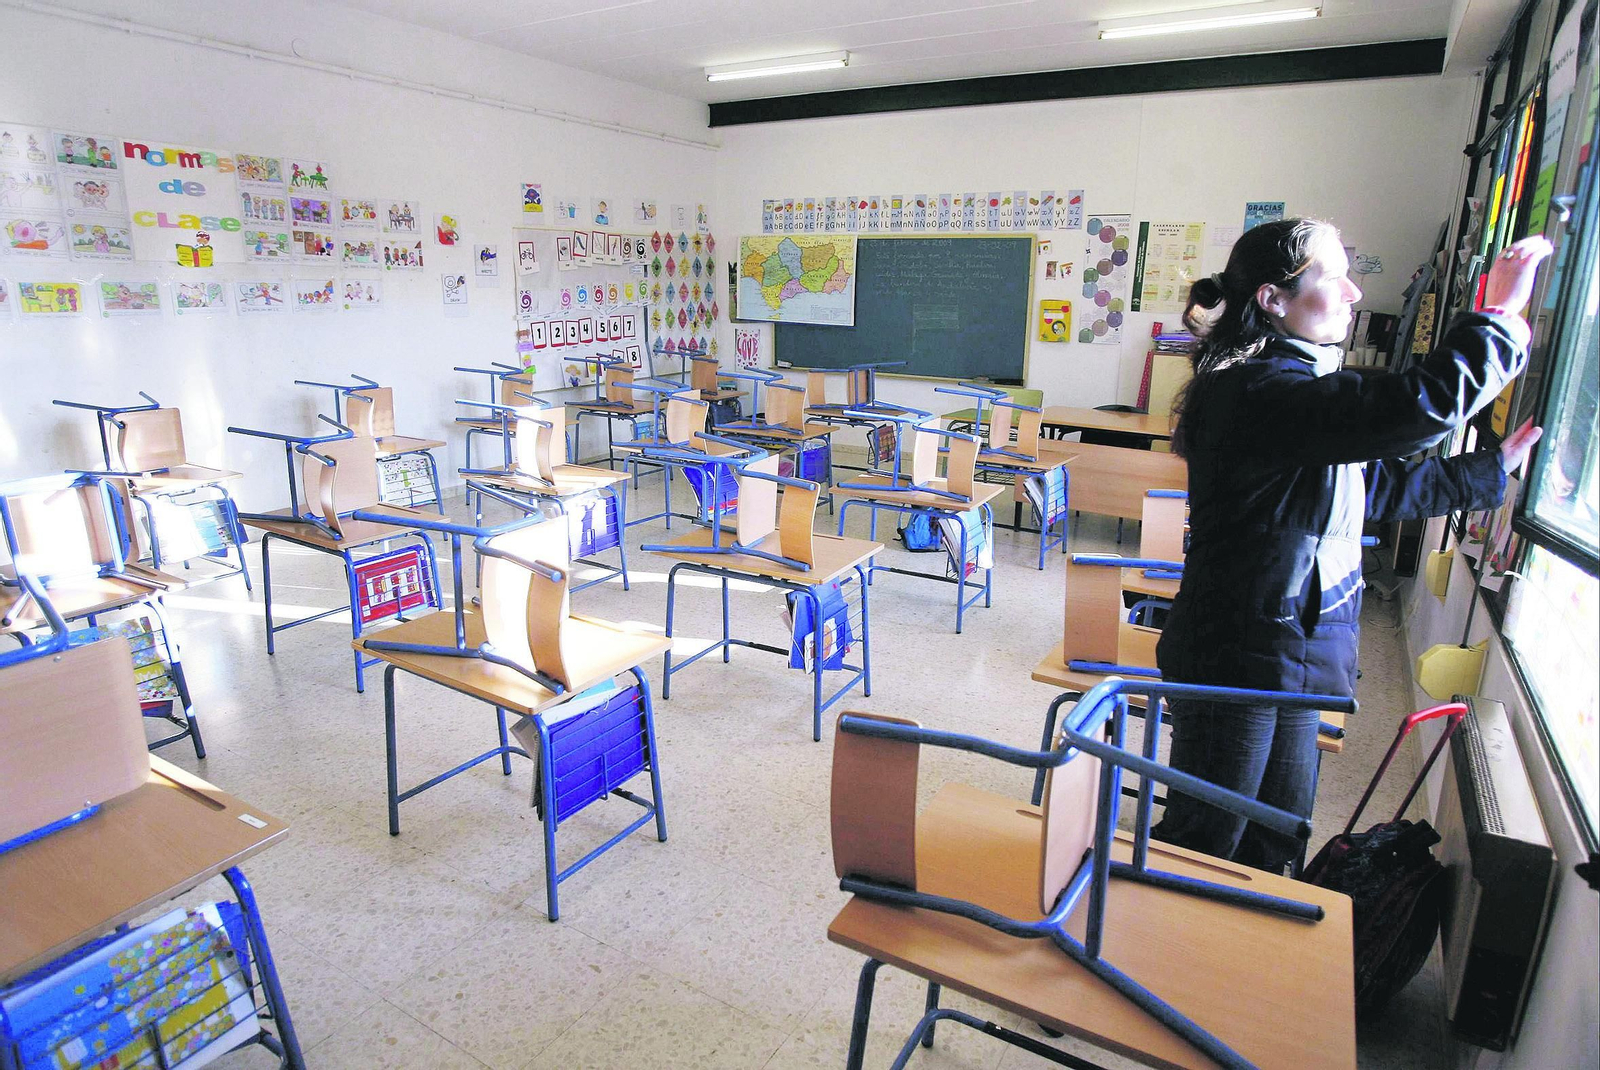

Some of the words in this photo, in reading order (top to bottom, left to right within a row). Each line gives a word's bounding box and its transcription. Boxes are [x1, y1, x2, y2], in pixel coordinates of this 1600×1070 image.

[124, 142, 235, 172] normas
[158, 179, 206, 197] de
[537, 328, 540, 339] 1
[556, 328, 560, 338] 2
[570, 327, 576, 337] 3
[584, 324, 588, 334] 4
[600, 323, 605, 332] 5
[613, 322, 618, 331] 6
[626, 321, 632, 330] 7
[631, 352, 637, 361] 8
